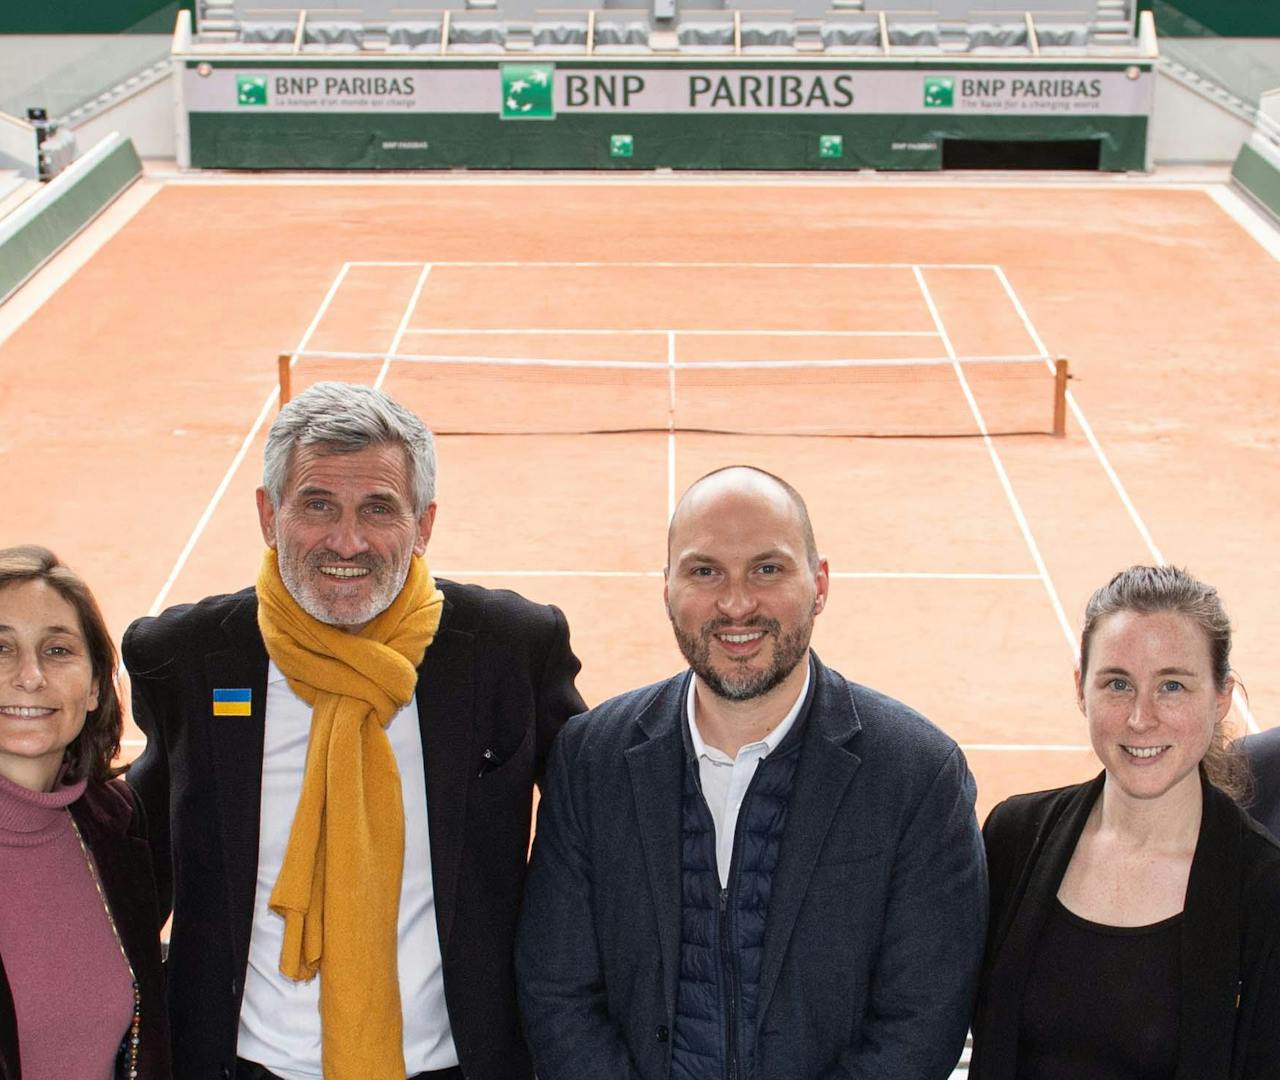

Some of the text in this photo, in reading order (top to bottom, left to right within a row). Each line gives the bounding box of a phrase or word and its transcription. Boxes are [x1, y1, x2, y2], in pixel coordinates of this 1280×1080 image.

[275, 76, 415, 95] BNP PARIBAS
[566, 75, 855, 108] BNP PARIBAS
[961, 79, 1101, 97] BNP PARIBAS
